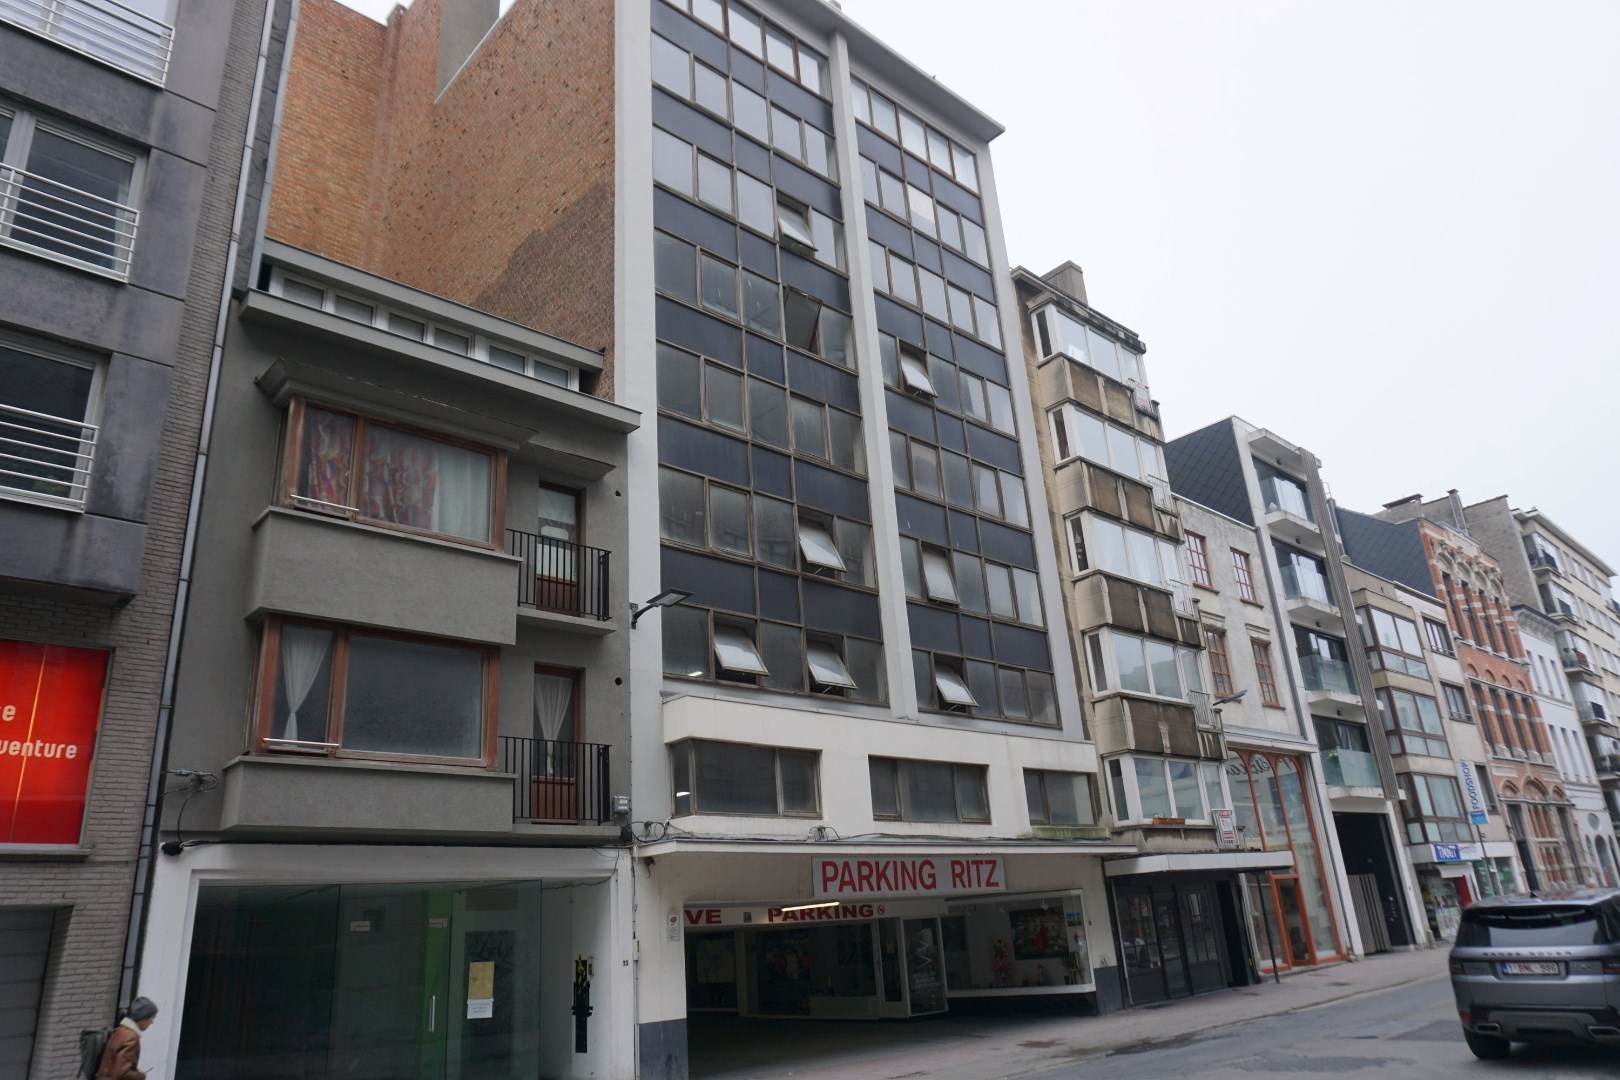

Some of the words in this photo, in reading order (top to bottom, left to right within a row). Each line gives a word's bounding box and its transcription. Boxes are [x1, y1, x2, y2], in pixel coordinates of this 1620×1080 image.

[1461, 762, 1480, 810] FOODSHOP
[821, 860, 937, 892] PARKING
[951, 860, 999, 888] RITZ
[767, 904, 873, 922] PARKING
